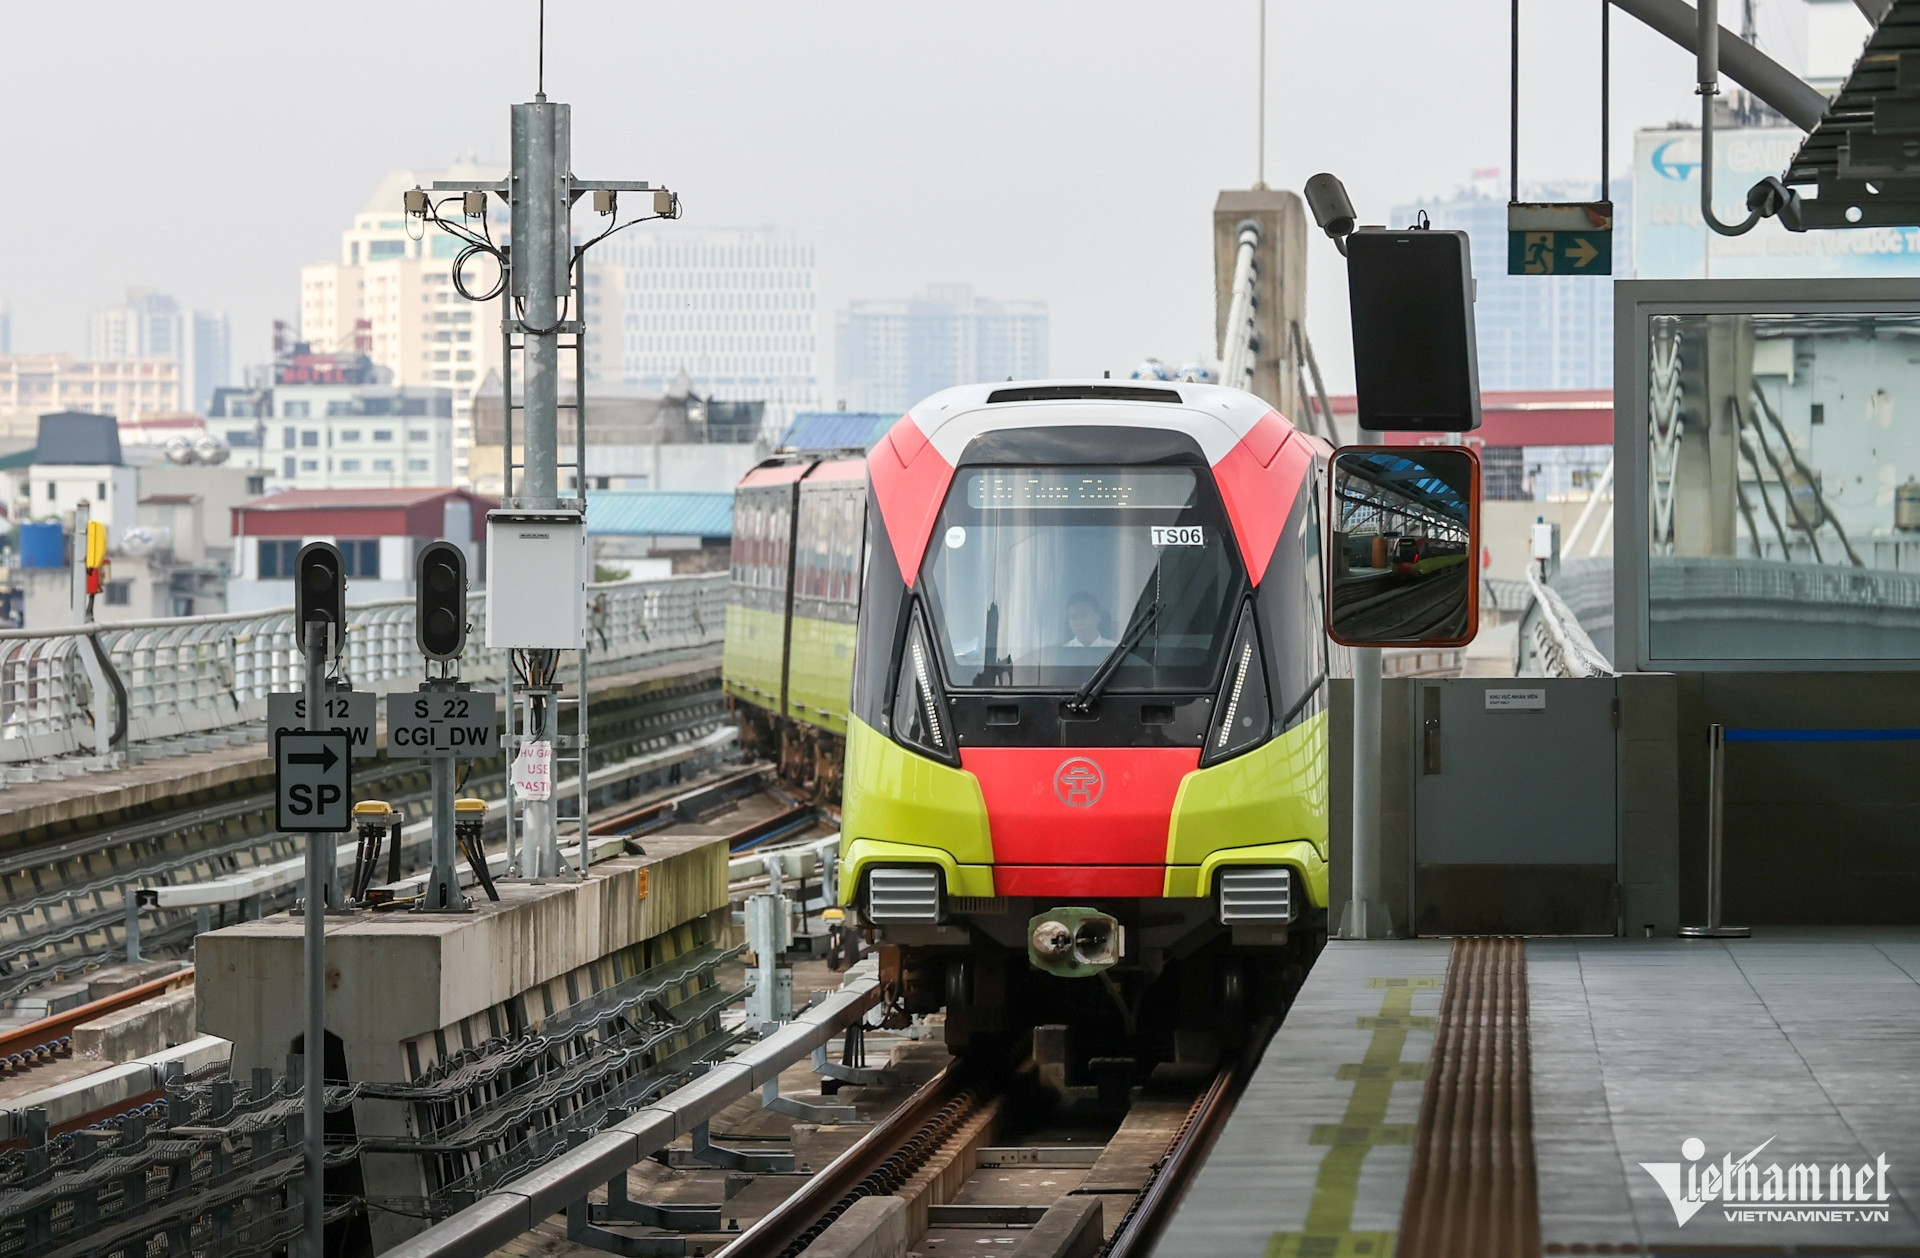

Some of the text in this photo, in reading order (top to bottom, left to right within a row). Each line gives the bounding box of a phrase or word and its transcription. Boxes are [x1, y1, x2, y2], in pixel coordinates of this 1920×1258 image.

[1153, 529, 1200, 544] TS06
[295, 700, 349, 718] S12
[288, 784, 341, 815] SP
